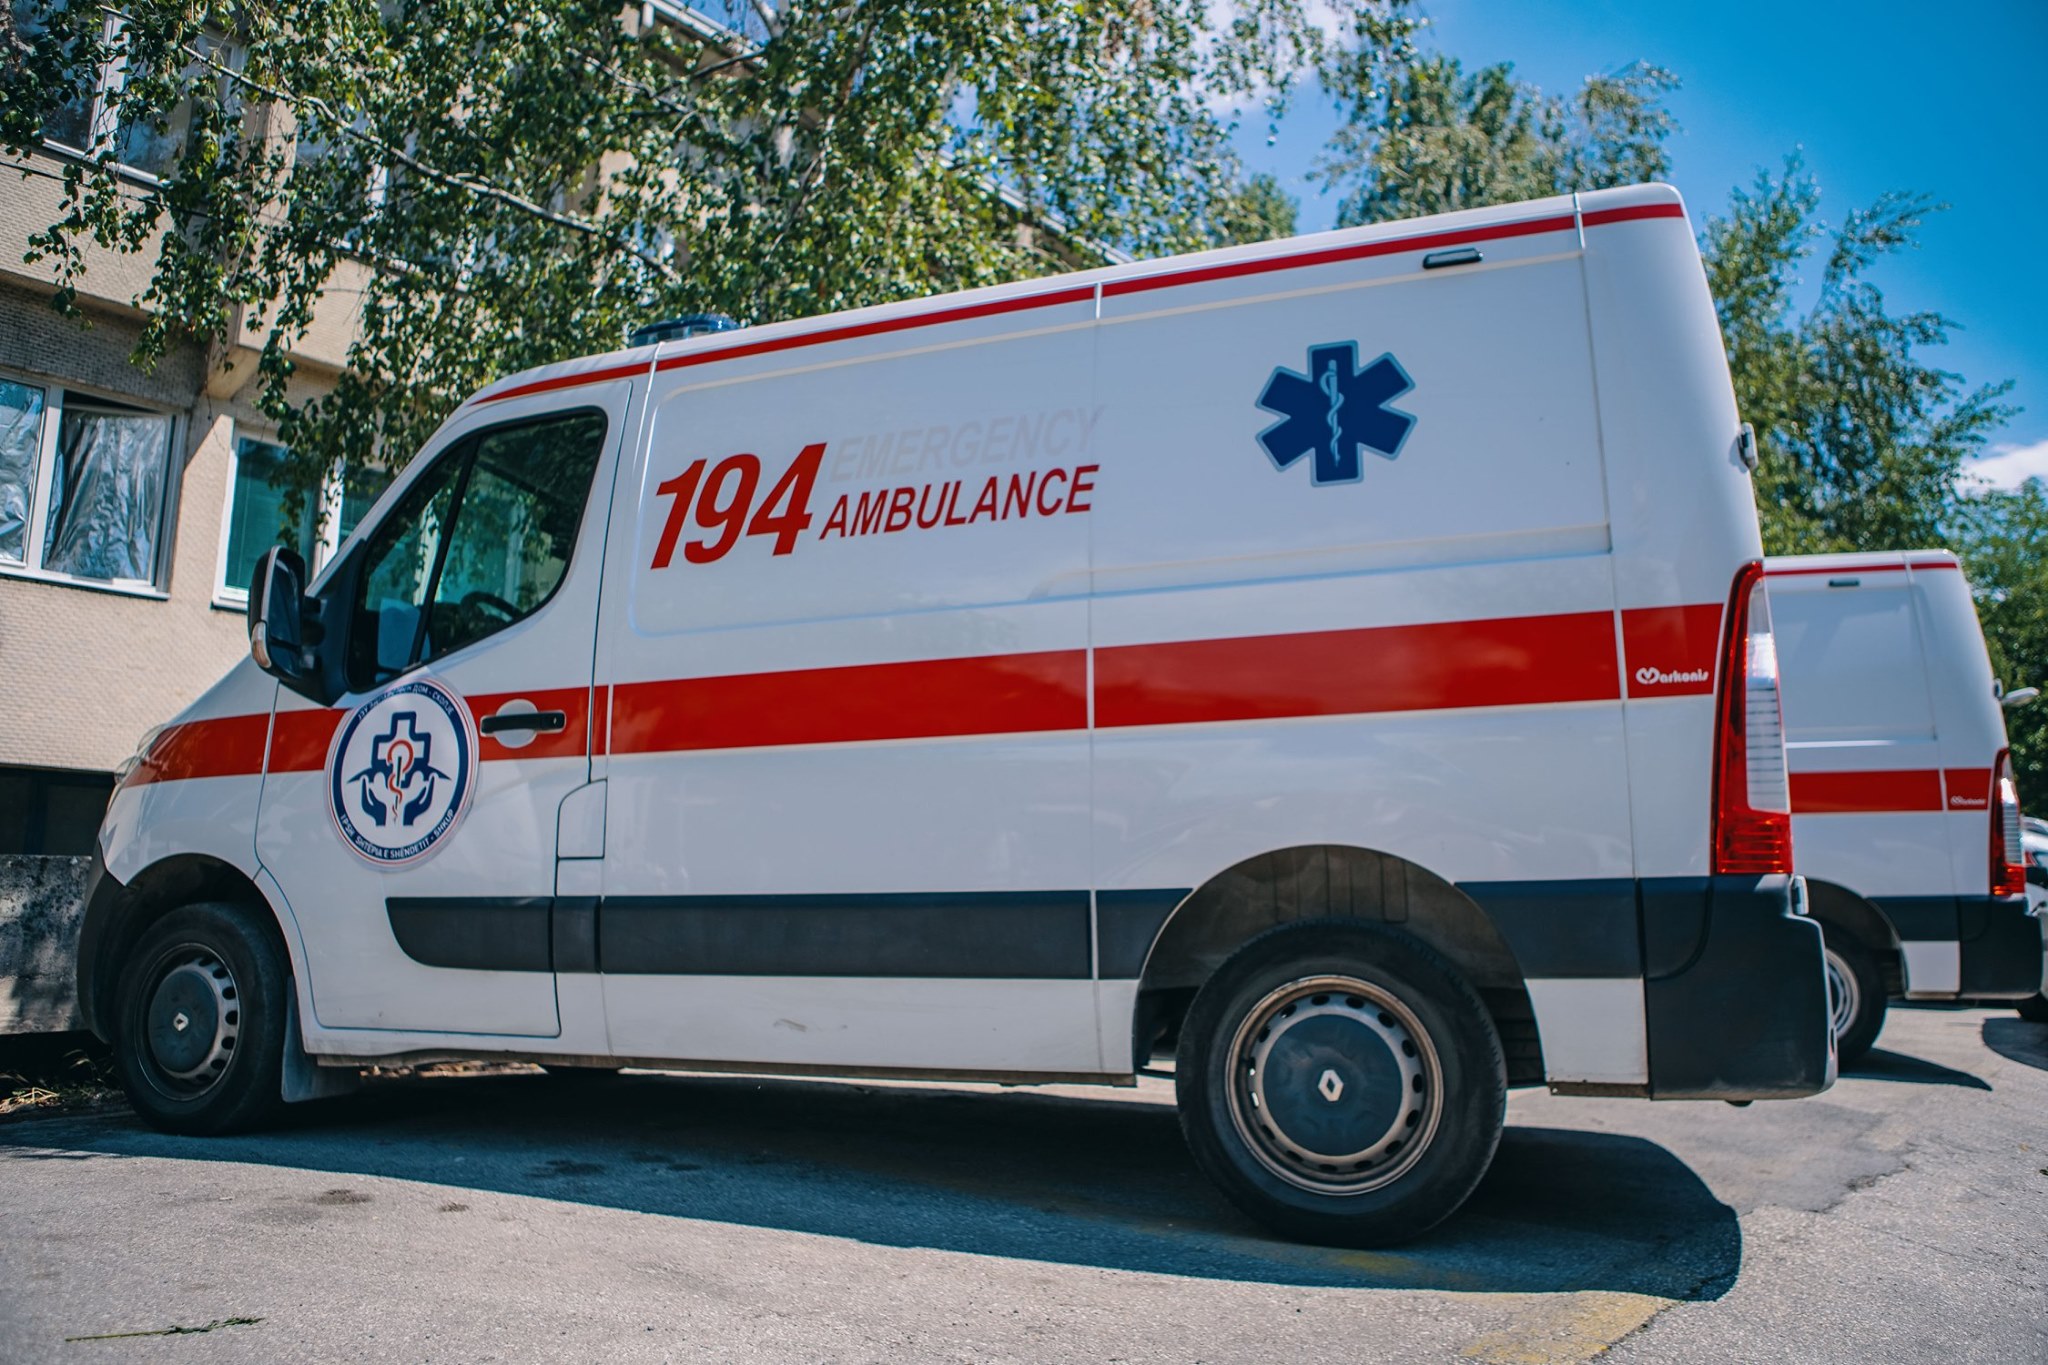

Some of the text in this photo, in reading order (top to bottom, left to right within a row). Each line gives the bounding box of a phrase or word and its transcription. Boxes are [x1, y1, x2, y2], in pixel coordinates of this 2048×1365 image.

[830, 404, 1105, 483] EMERGENCY
[650, 442, 827, 570] 194
[819, 464, 1100, 540] AMBULANCE
[383, 849, 389, 858] E
[390, 838, 429, 859] SHËNDETIT
[433, 808, 454, 838] SHKUP
